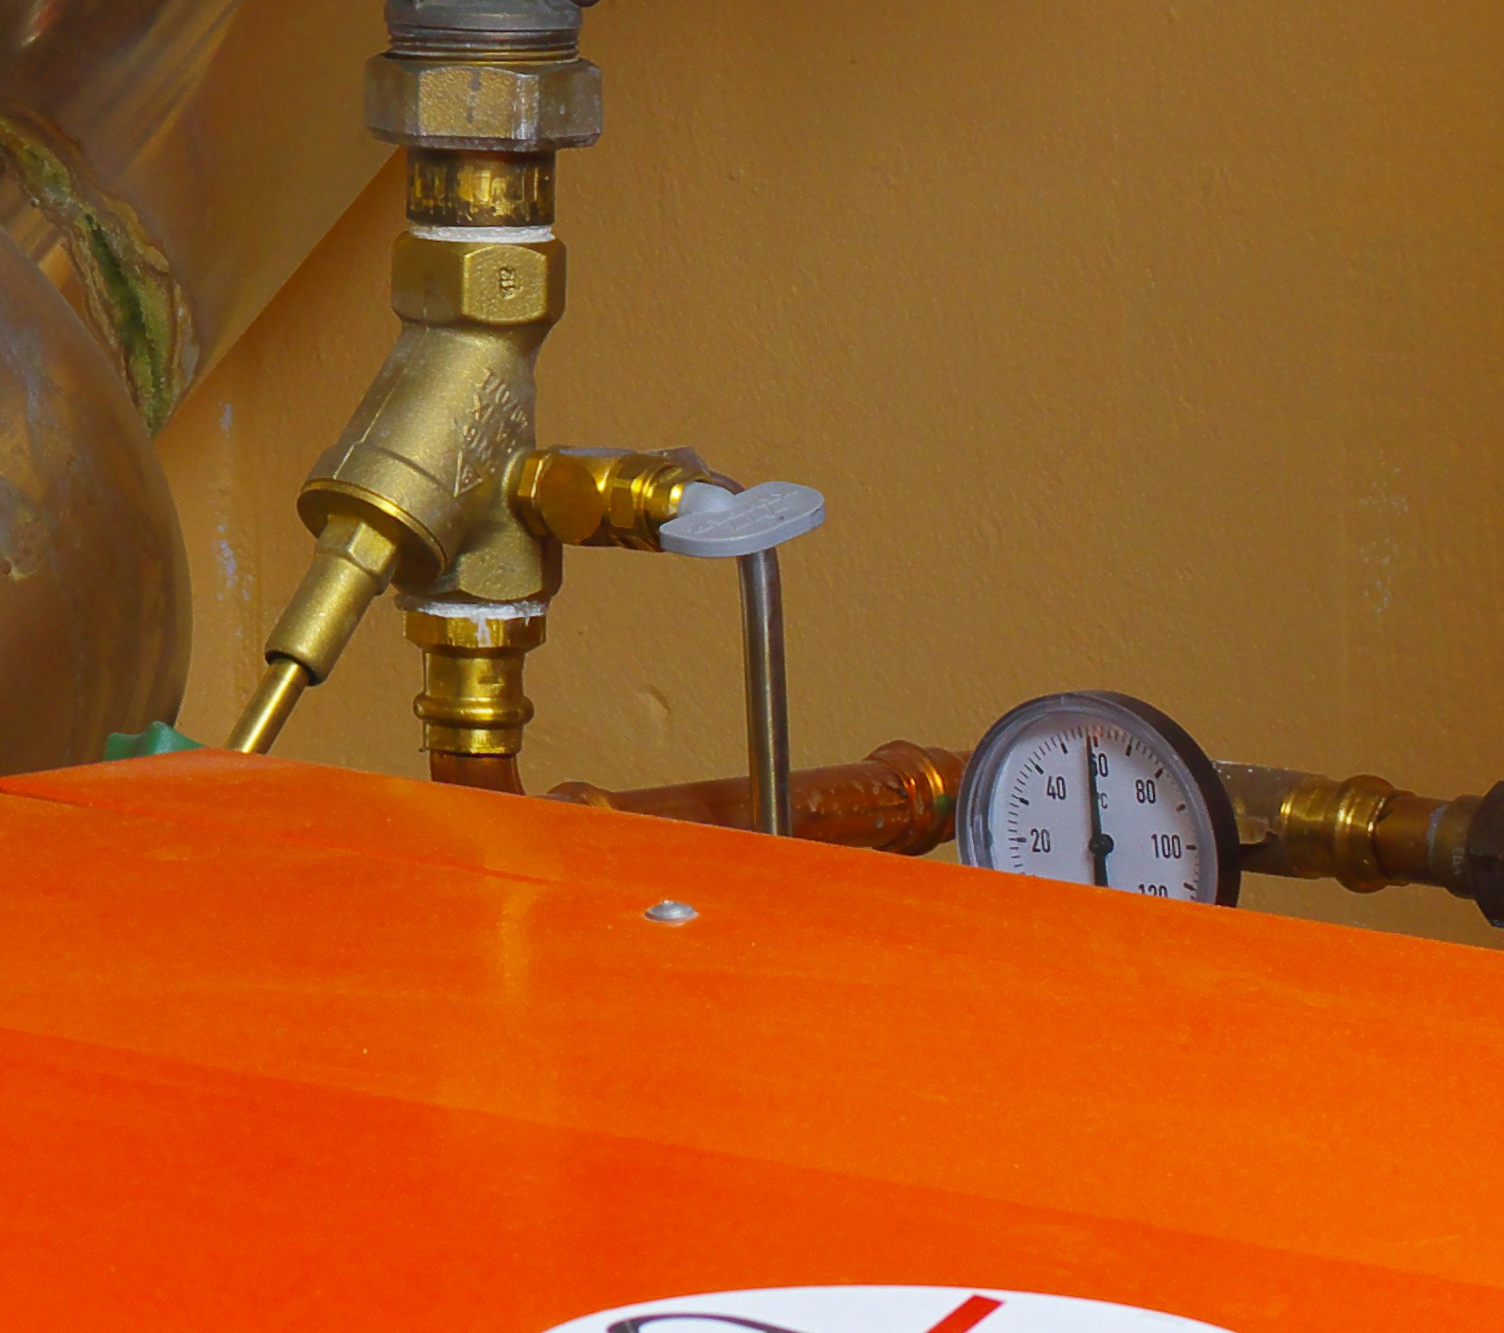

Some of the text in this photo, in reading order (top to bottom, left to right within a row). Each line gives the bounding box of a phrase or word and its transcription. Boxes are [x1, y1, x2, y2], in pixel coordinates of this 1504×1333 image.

[1046, 776, 1066, 799] 40
[1136, 780, 1156, 804] 80
[1031, 829, 1051, 853] 20
[1151, 833, 1181, 859] 100
